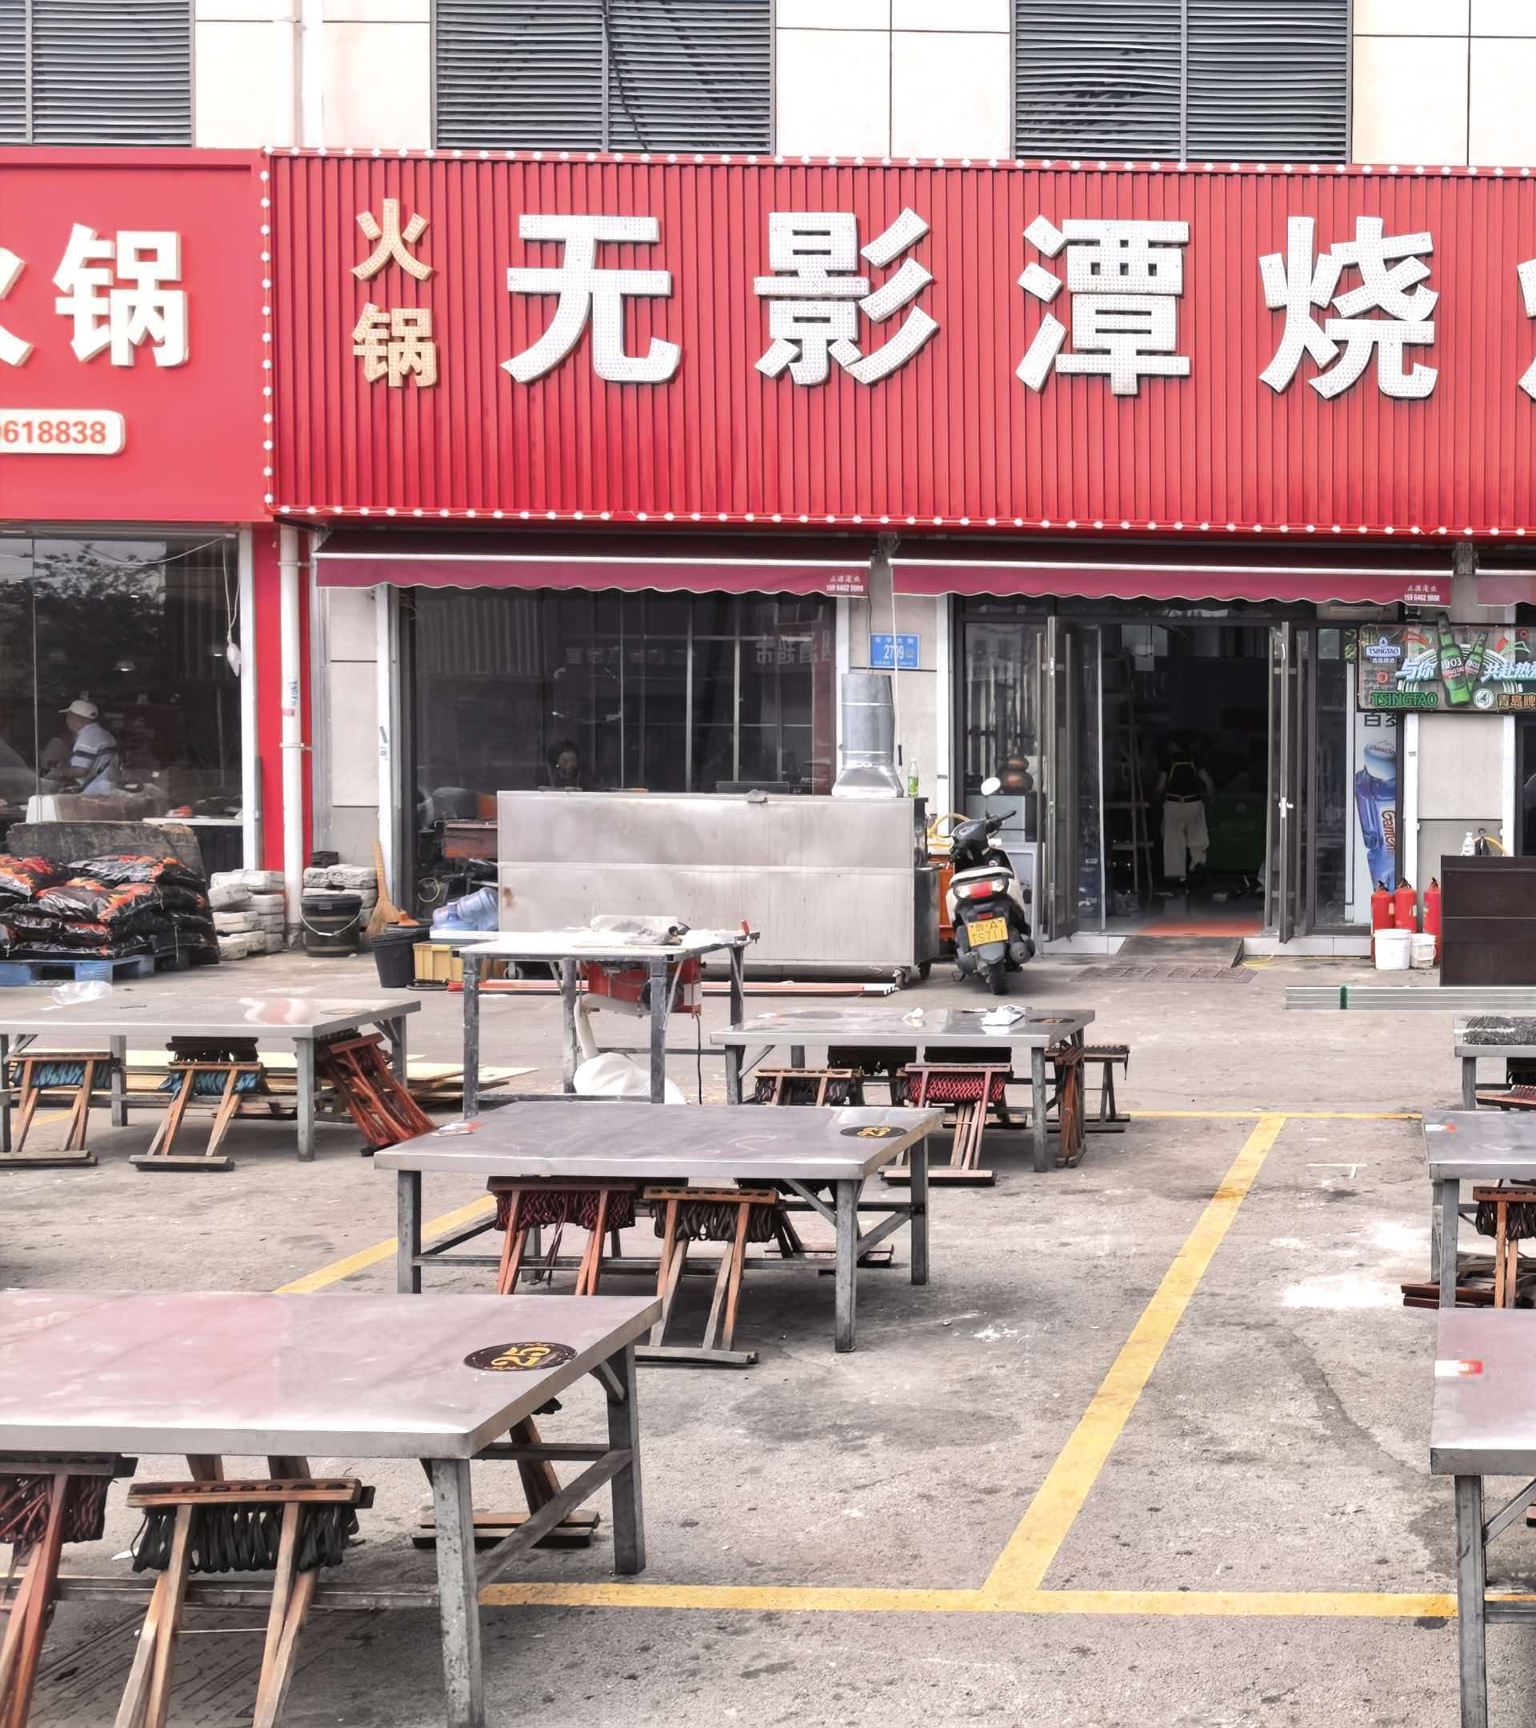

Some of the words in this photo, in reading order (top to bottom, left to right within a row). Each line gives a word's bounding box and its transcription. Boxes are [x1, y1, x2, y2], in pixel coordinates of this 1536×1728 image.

[0, 222, 190, 368] 锅
[350, 197, 439, 389] 火锅
[0, 419, 107, 445] 618838
[1368, 647, 1400, 656] TSINGTAO
[1396, 658, 1436, 683] 与你
[1370, 691, 1439, 708] TSINGTAO
[491, 1346, 551, 1368] 25
